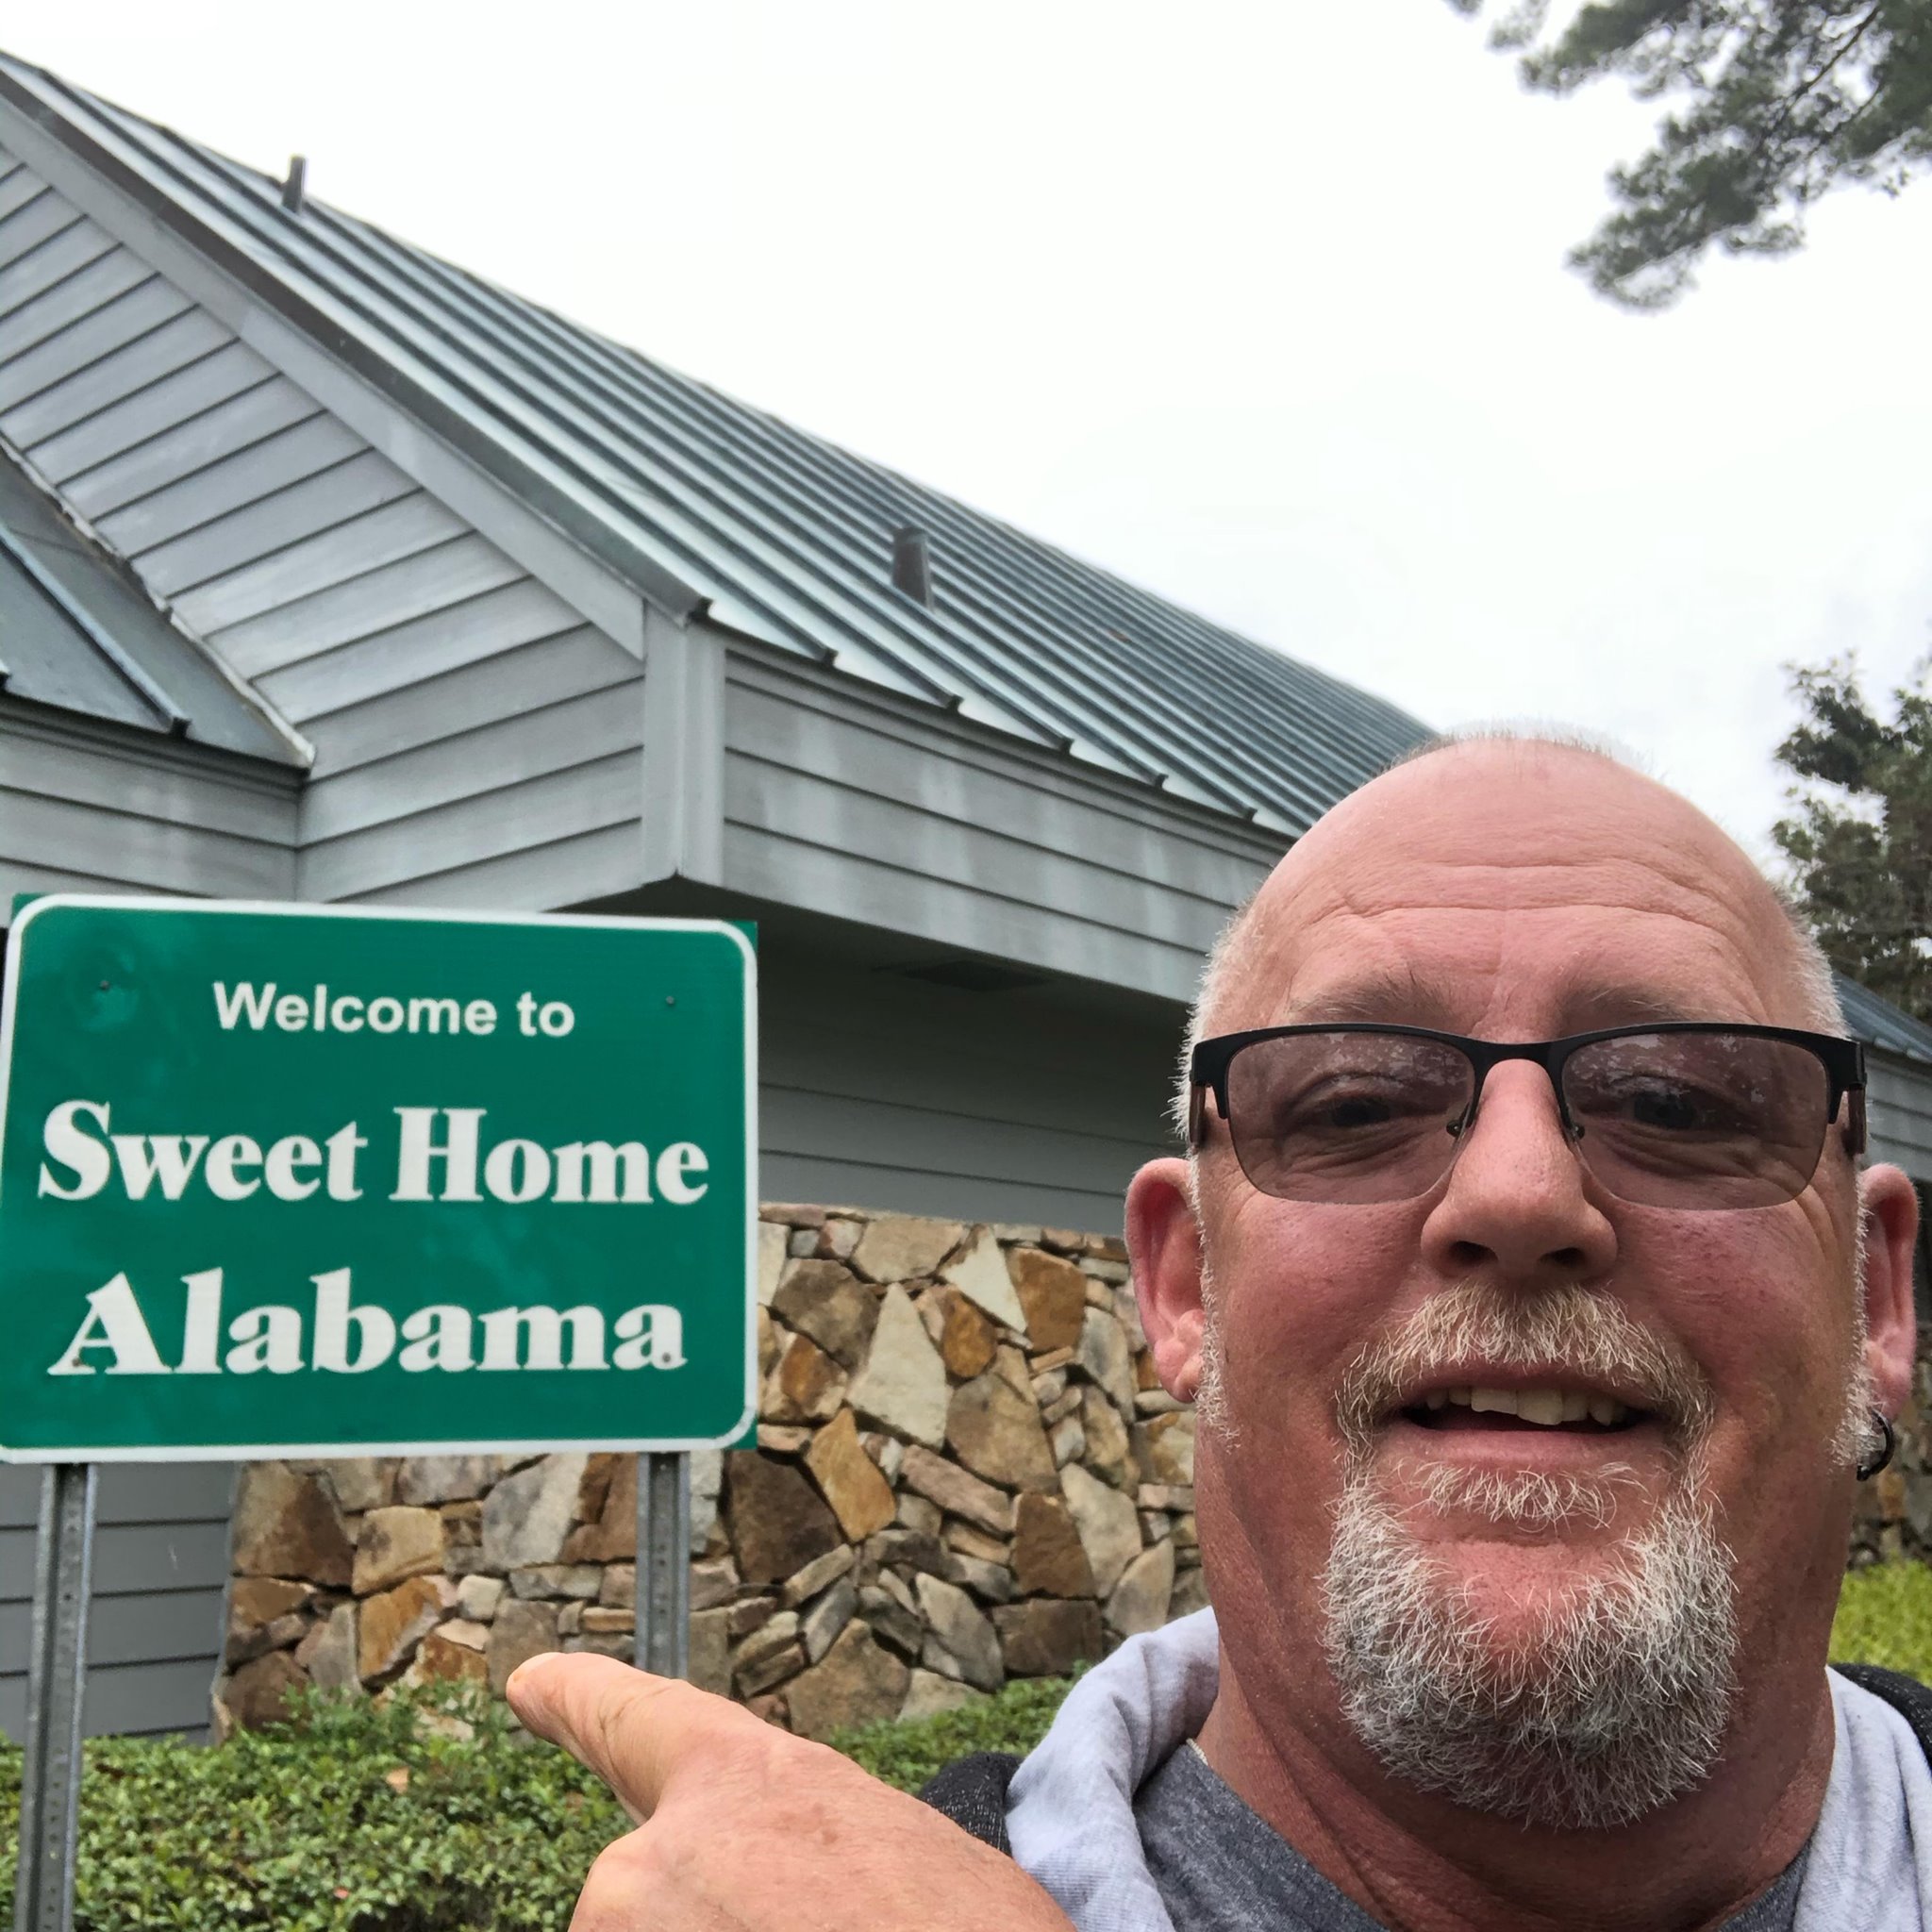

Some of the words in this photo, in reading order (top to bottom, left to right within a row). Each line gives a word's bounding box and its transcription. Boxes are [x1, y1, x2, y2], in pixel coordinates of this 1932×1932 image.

[213, 981, 497, 1036] Welcome
[517, 991, 575, 1037] to
[38, 1099, 368, 1201] Sweet
[389, 1107, 709, 1205] Home
[47, 1266, 687, 1376] Alabama
